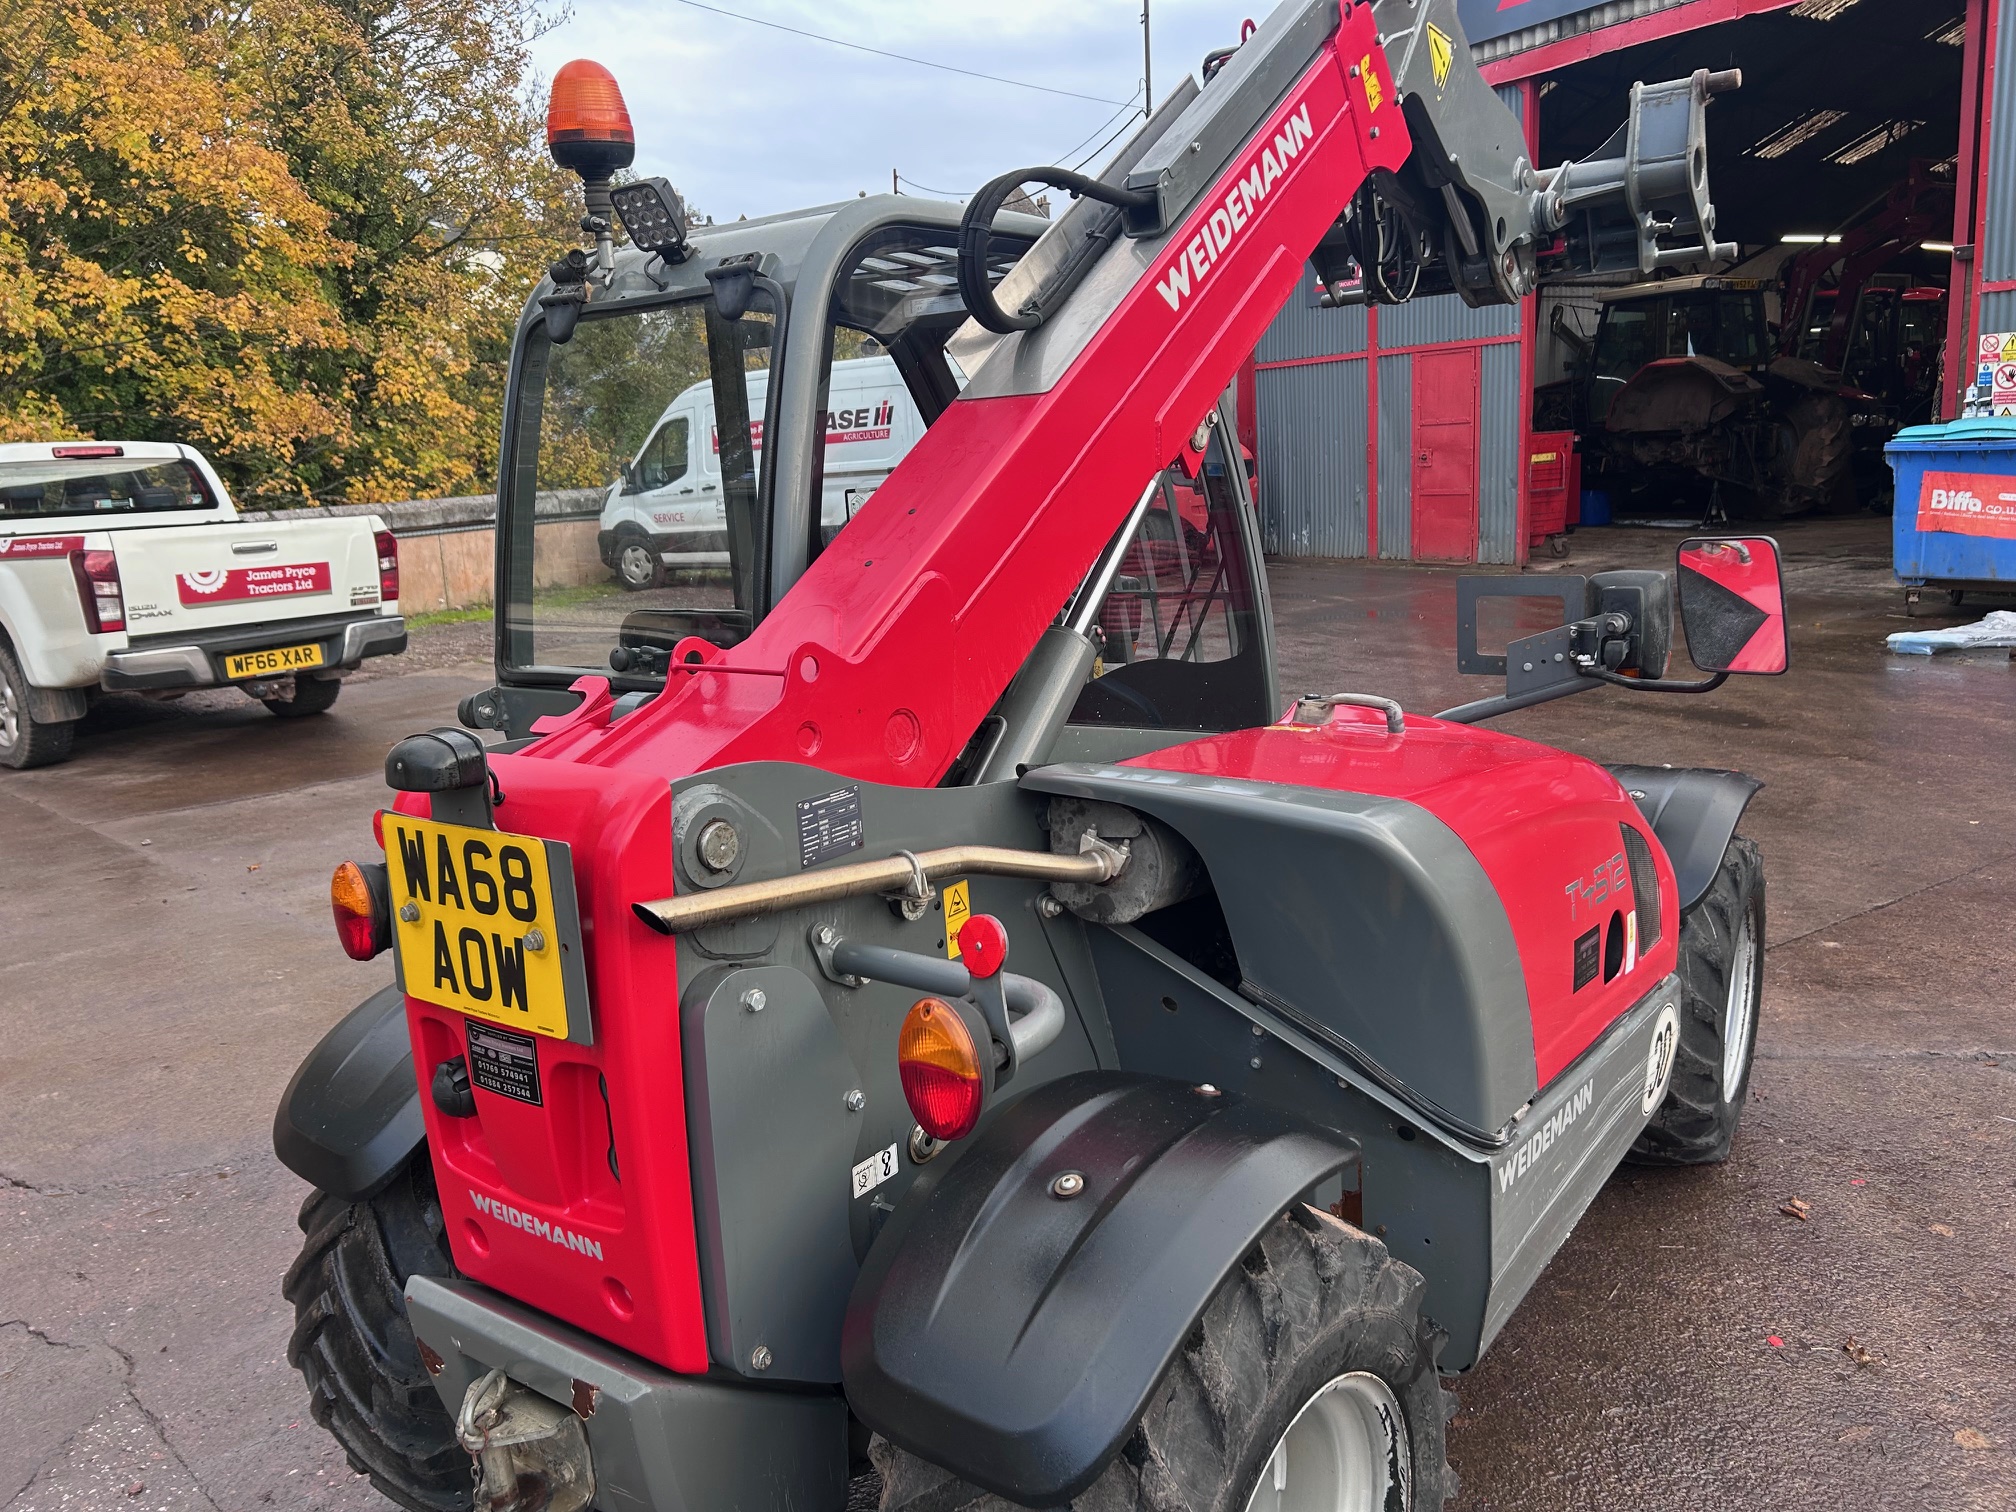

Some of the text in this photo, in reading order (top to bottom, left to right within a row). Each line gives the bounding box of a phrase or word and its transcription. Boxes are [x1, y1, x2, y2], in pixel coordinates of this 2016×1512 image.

[1155, 101, 1314, 312] WEIDEMANN
[825, 408, 869, 431] ASE
[843, 430, 889, 441] AGRICULTURE
[653, 512, 686, 523] SERVICE
[246, 566, 316, 582] James Pryce
[247, 579, 313, 595] Tractors Ltd
[233, 647, 315, 674] WF66 XAR
[396, 826, 538, 923] WA68
[434, 919, 529, 1013] AOW
[477, 1060, 499, 1074] 01769
[500, 1068, 529, 1083] 574941
[502, 1083, 531, 1098] 257544
[1498, 1077, 1594, 1194] WEIDEMANN
[468, 1189, 604, 1262] WEIDEMANN
